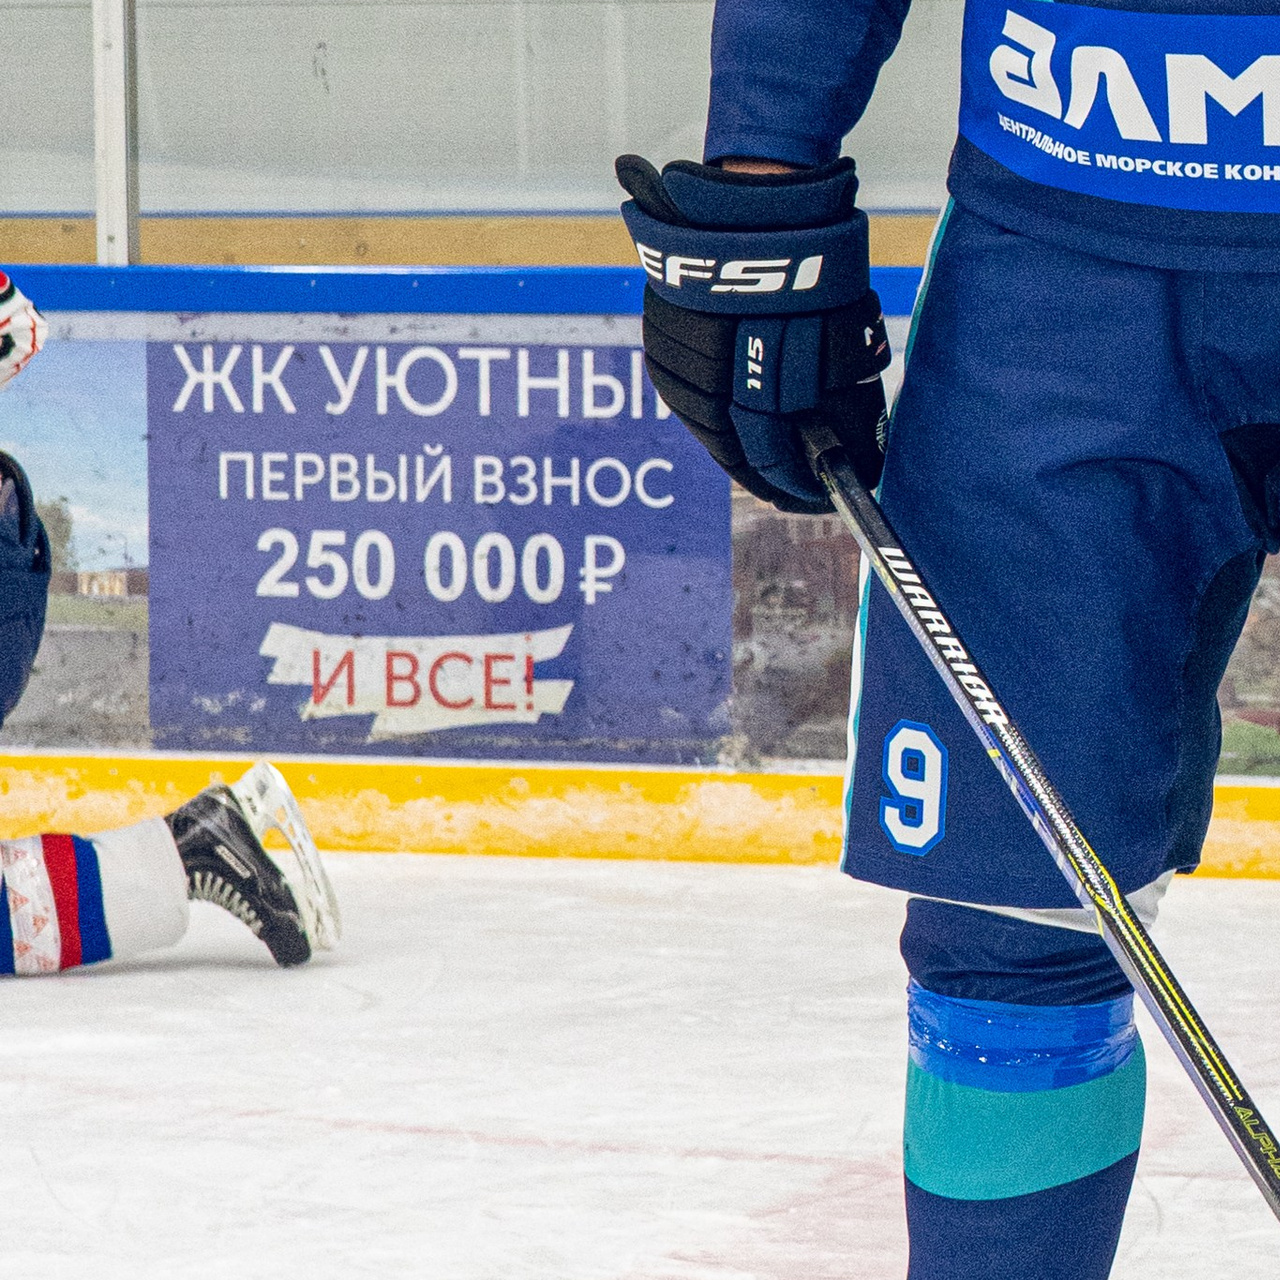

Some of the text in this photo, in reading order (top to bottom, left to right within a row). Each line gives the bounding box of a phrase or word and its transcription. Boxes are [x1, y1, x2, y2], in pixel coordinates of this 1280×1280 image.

[997, 112, 1091, 166] ЦЕНТРАЛЬНОЕ
[1096, 153, 1219, 179] МОРСКОЕ
[637, 243, 823, 293] EFSI
[172, 345, 672, 420] ЖК УЮТНЫ
[218, 445, 675, 508] ПЕРВЫЙ ВЗНОС
[256, 528, 395, 600] 250
[876, 546, 1010, 732] WARRIOR
[311, 649, 536, 712] И ВСЕ!
[879, 719, 949, 857] 9
